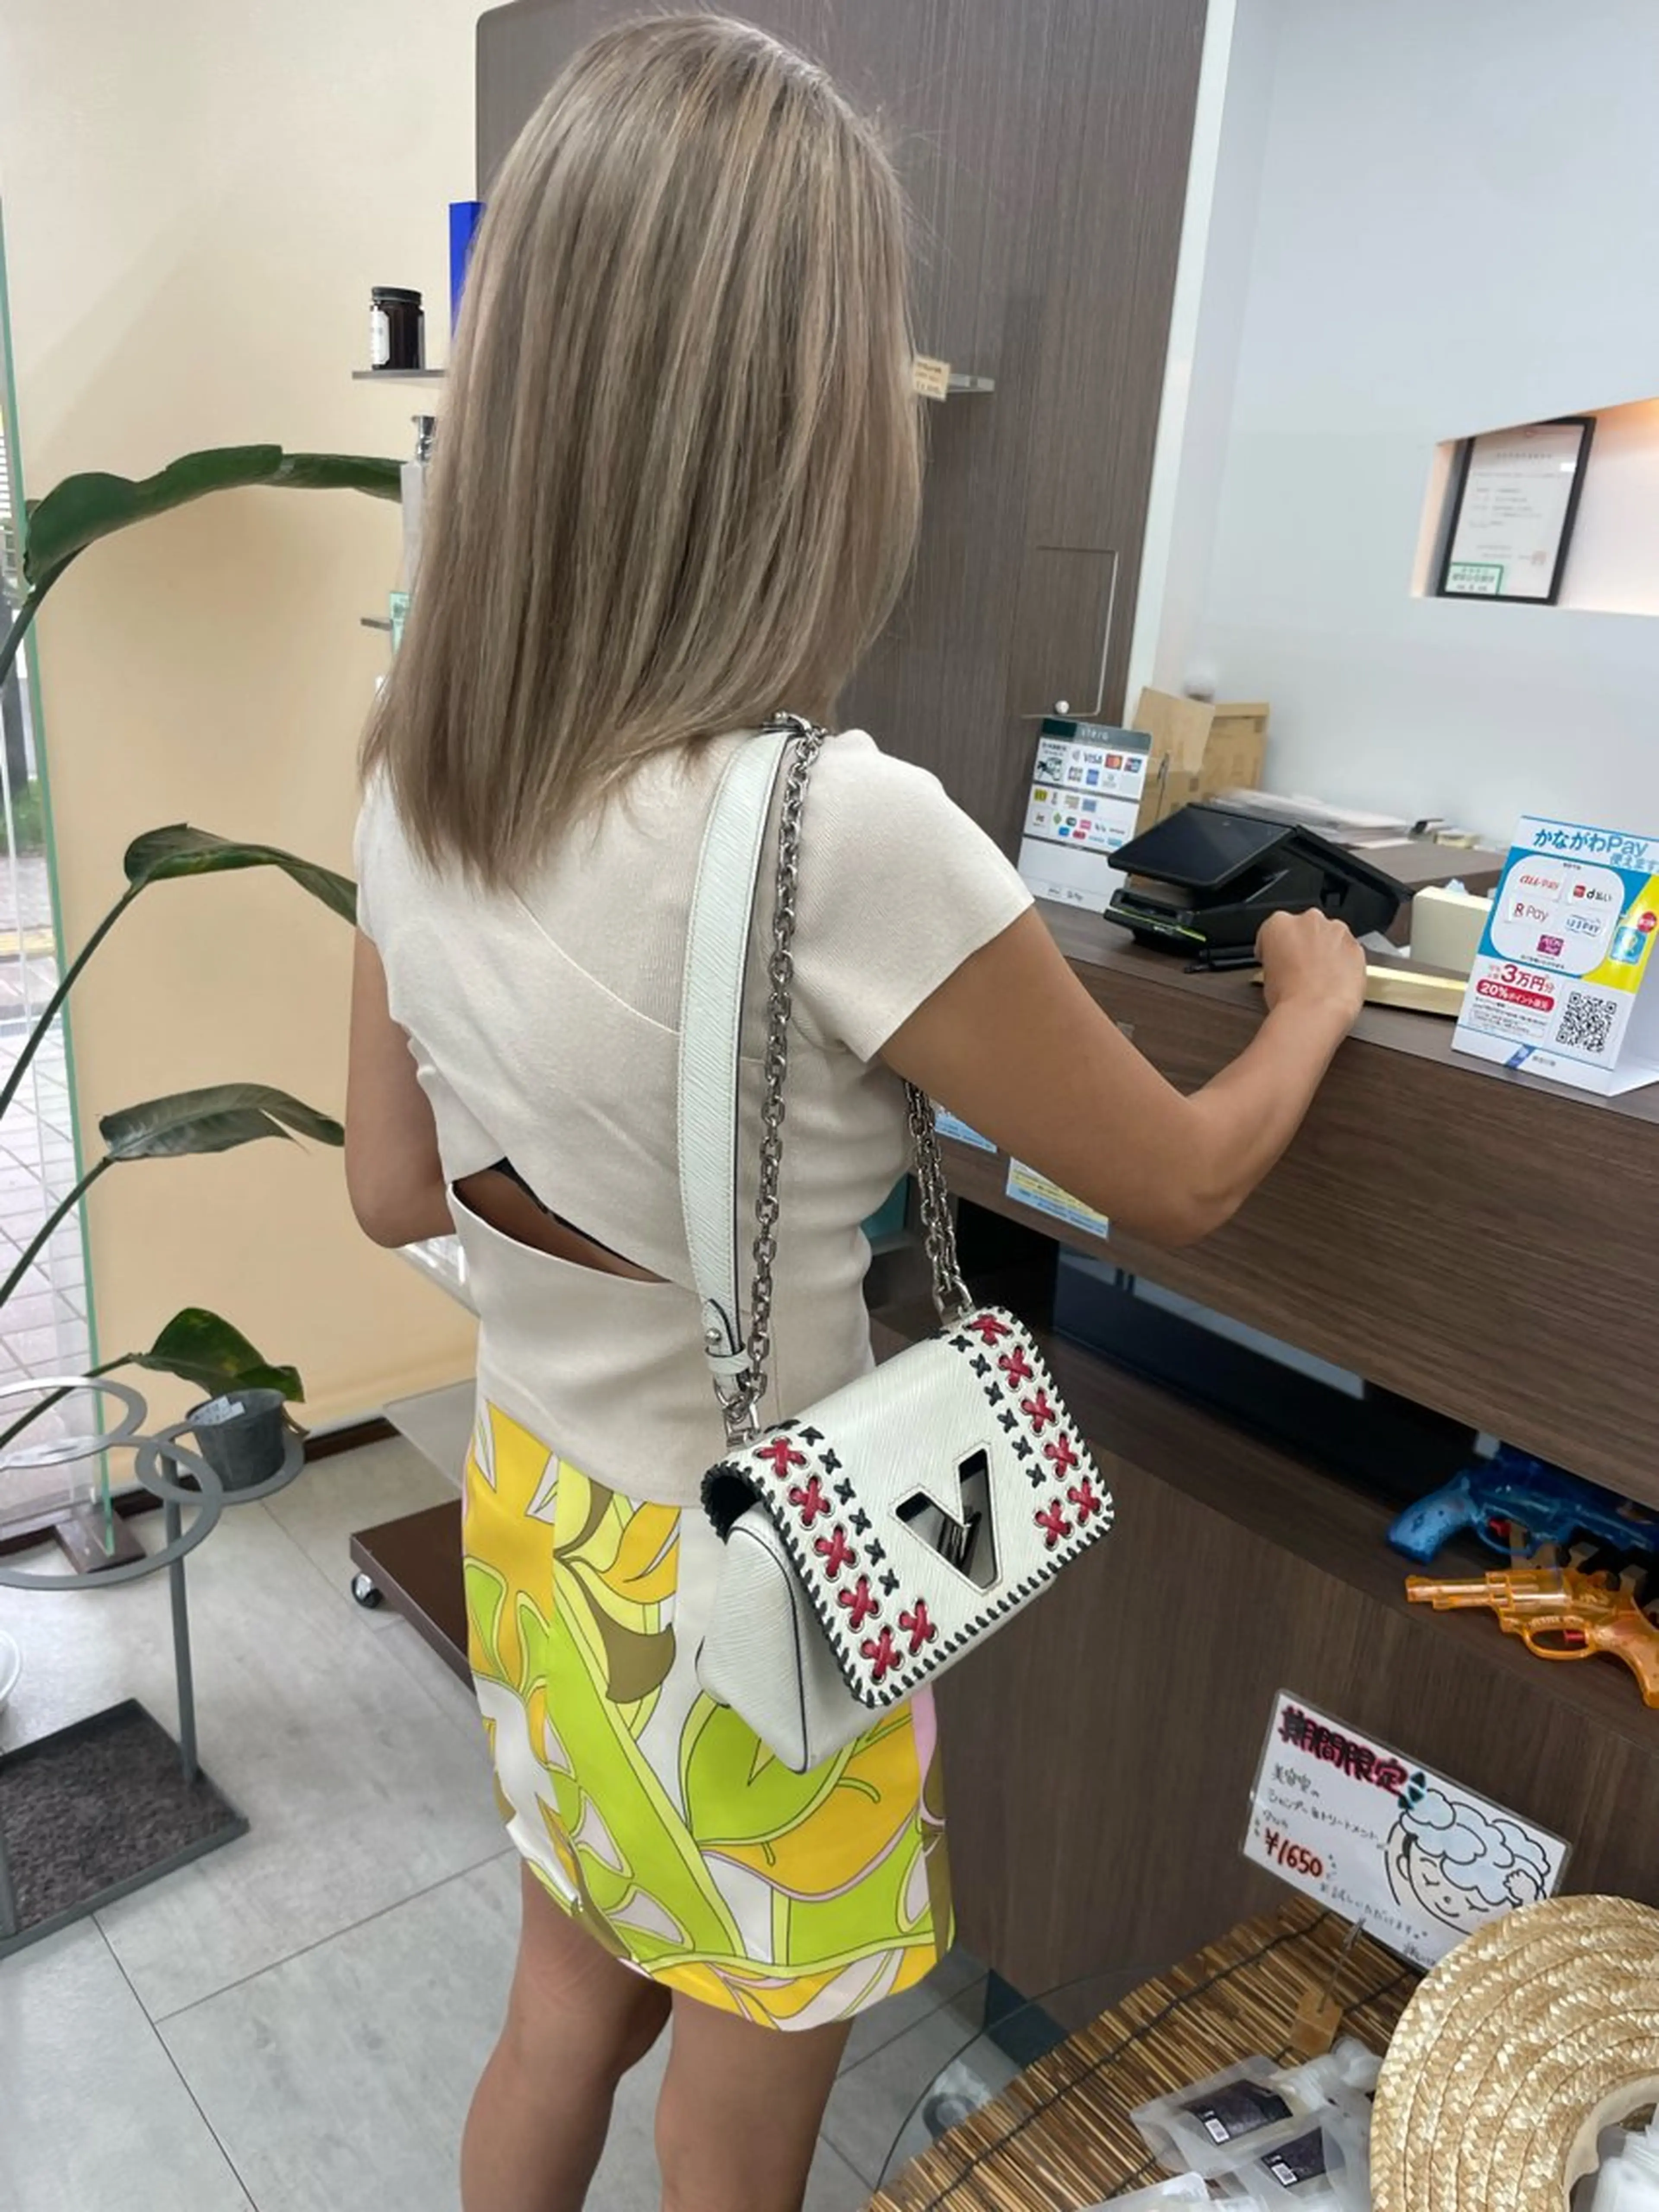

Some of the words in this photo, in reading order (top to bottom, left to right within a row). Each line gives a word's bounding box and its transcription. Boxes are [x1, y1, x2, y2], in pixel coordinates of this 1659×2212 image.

[1533, 829, 1649, 858] かながわPay
[1278, 1706, 1408, 1796] 期間限定
[1265, 1827, 1323, 1877] ¥1650
